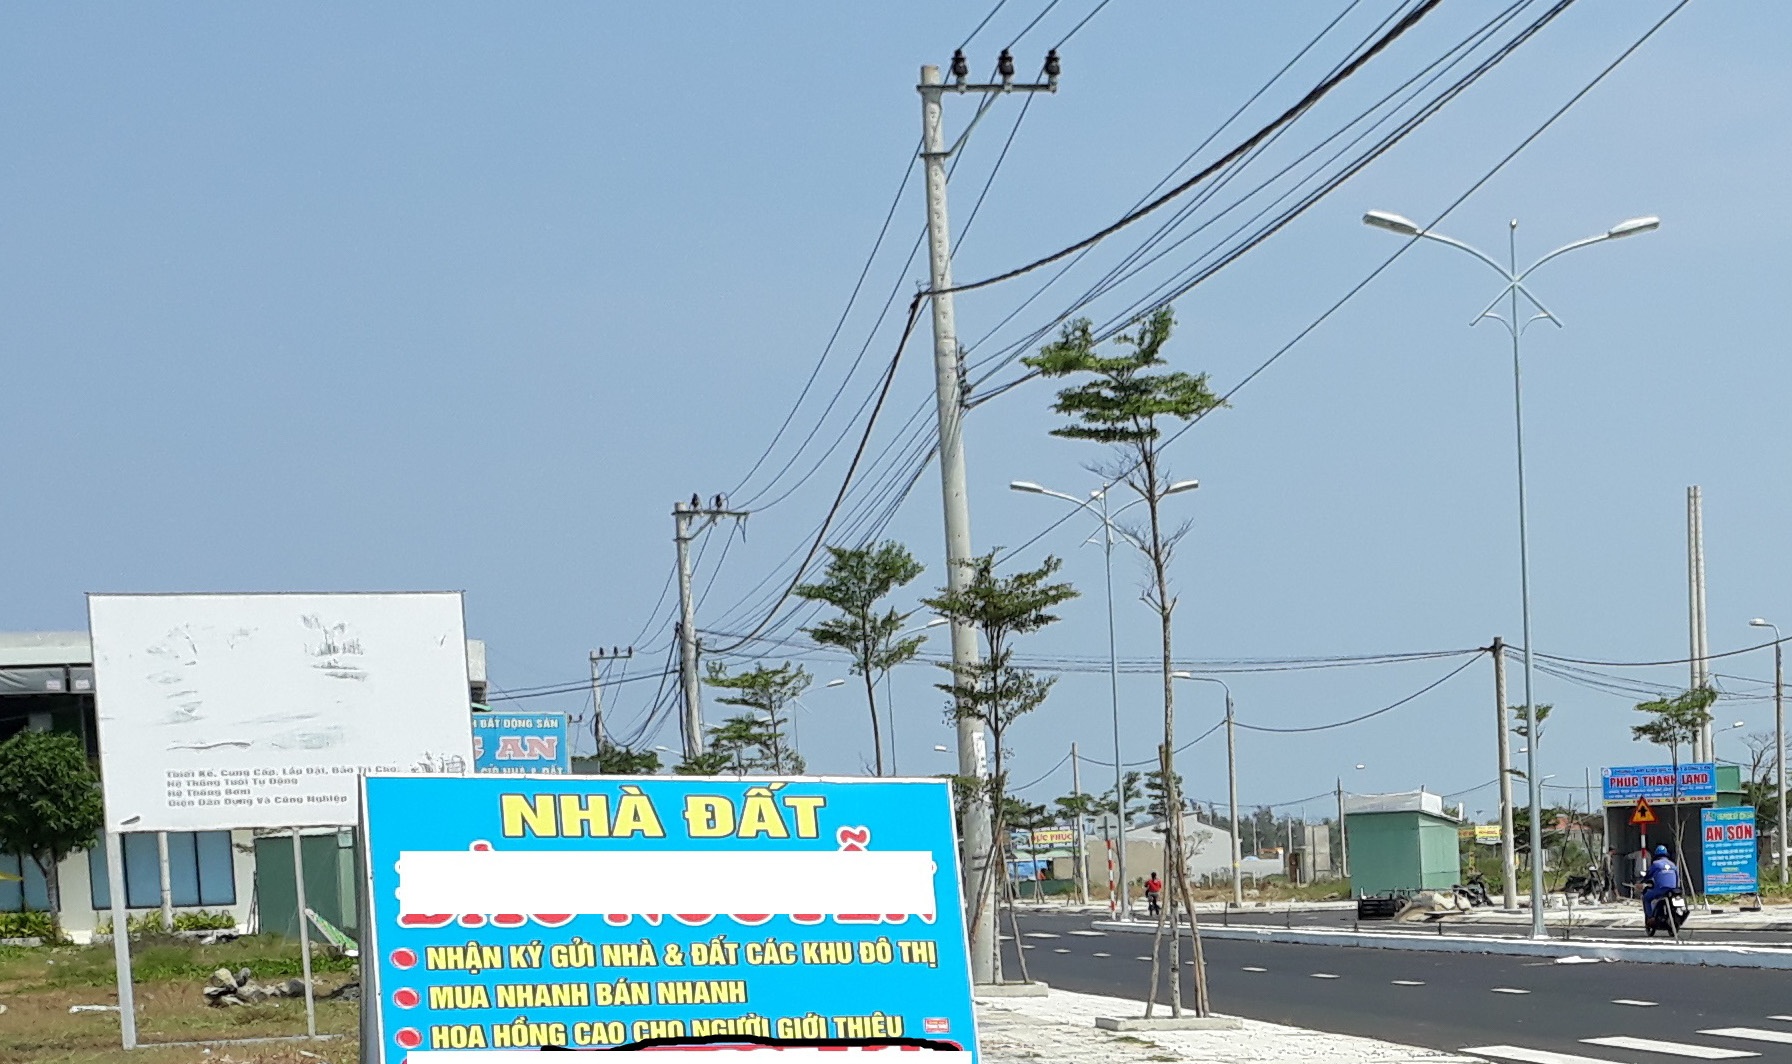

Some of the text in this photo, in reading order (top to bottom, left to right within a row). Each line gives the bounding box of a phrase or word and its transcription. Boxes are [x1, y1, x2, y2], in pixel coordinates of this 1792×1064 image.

[496, 735, 558, 760] AN
[1681, 773, 1708, 785] LAND
[500, 783, 827, 839] NHÀ ĐẤT
[1705, 826, 1723, 841] AN
[425, 934, 939, 975] NHẬN KÝ GỬI NHÀ & ĐẤT CÁC KHU ĐÔ THỊ
[429, 977, 748, 1010] MUA NHANH BÁN NHANH
[431, 1024, 488, 1050] HOA
[492, 1015, 568, 1048] HỒNG
[573, 1021, 626, 1046] CAO
[632, 1018, 686, 1042] CHO
[691, 1012, 770, 1038] NGƯỜI
[776, 1011, 828, 1039] GIỚI
